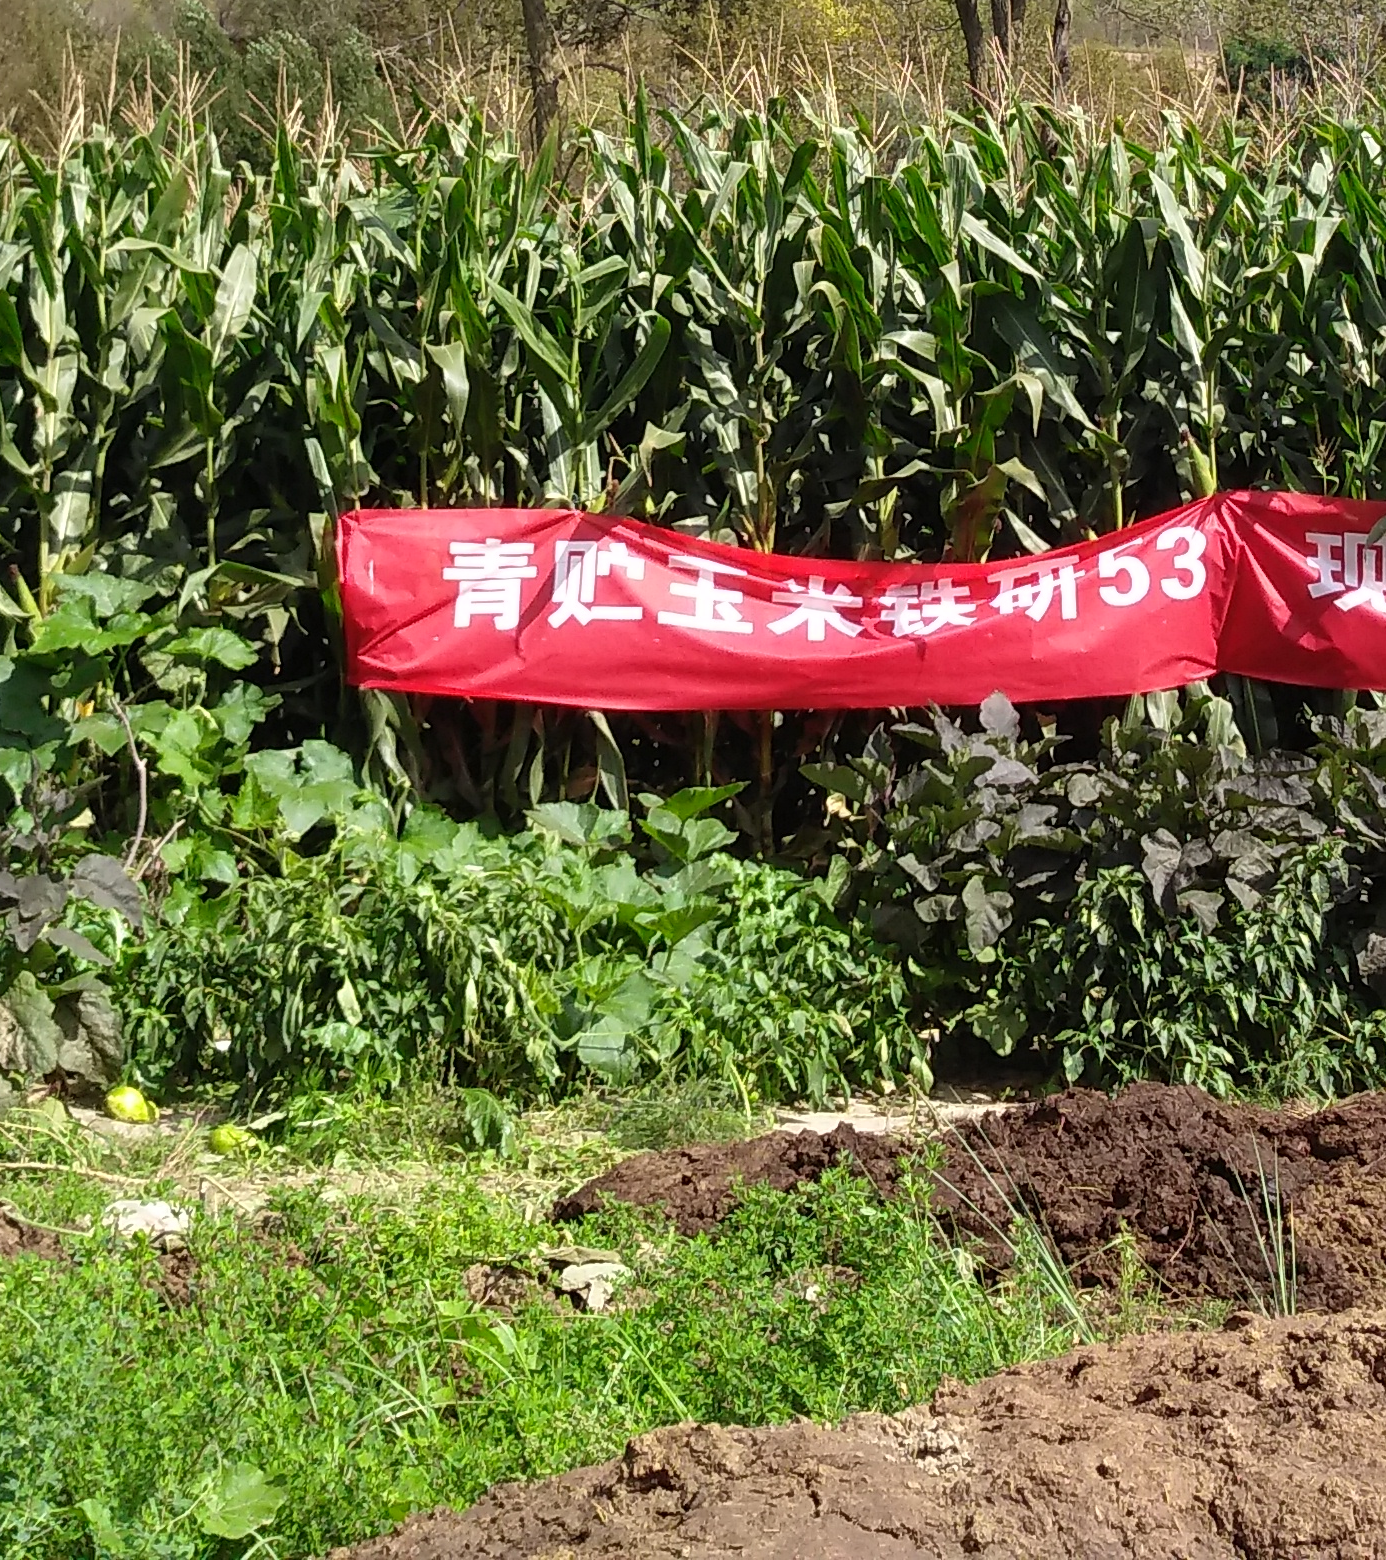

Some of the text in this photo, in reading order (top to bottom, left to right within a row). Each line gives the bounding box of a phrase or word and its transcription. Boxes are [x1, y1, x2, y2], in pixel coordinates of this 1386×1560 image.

[442, 524, 1208, 643] 青贮玉米铁研53
